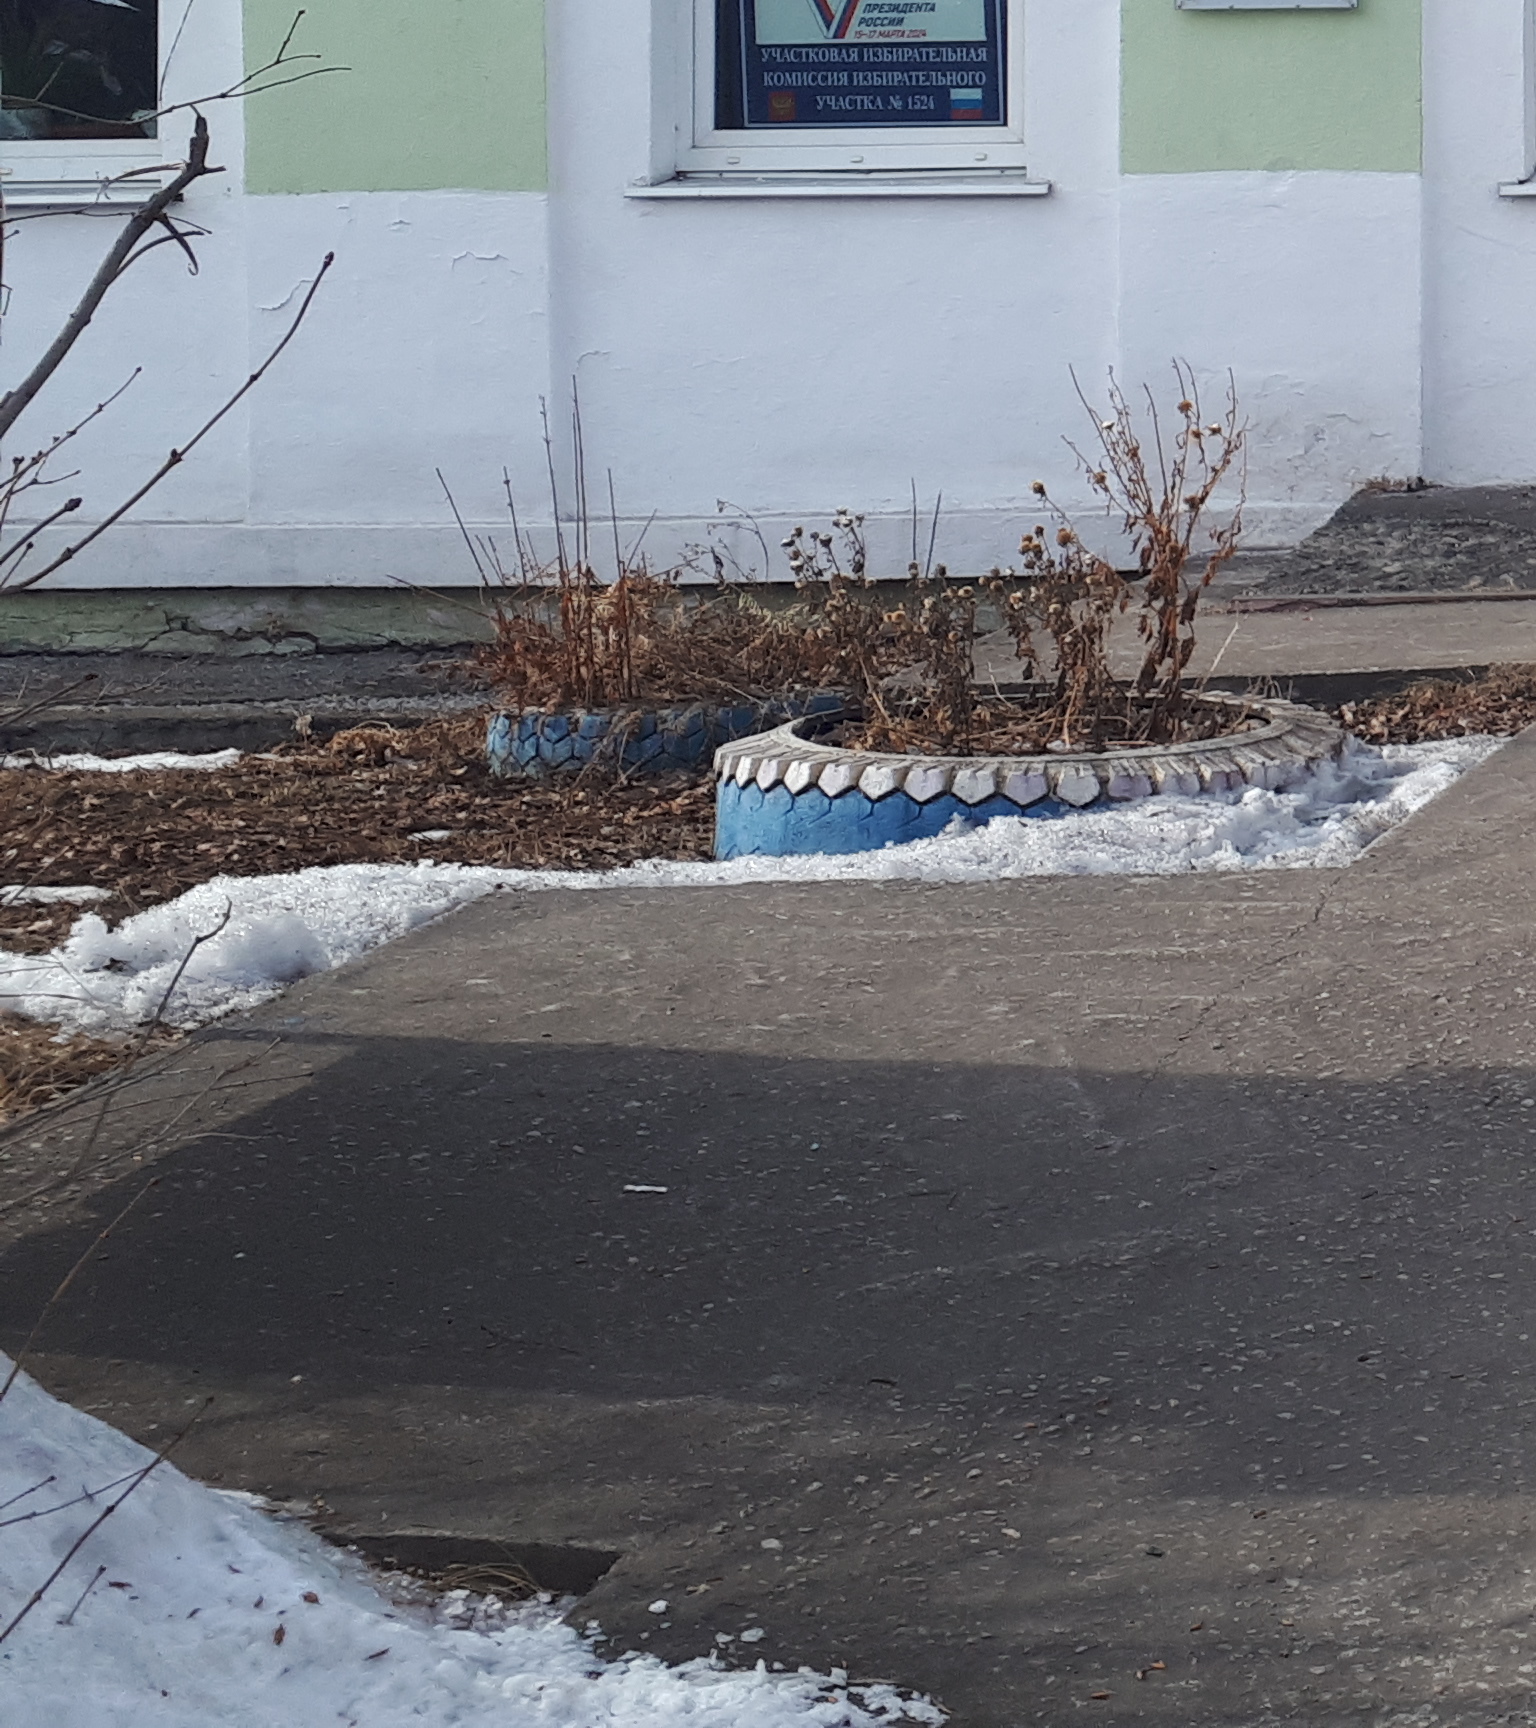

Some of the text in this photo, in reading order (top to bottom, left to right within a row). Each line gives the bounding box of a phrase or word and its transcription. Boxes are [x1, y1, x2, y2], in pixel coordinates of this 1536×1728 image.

[863, 2, 936, 14] ПРЕЗИДЕНТА
[857, 16, 905, 27] РОССИИ
[761, 47, 988, 63] УЧАСТКОВАЯ ИЗБИРАТЕЛЬНАЯ
[763, 71, 986, 87] КОМИССИЯ ИЗБИРАТЕЛЬНОГО
[815, 95, 884, 111] УЧАСТКА
[907, 95, 935, 110] 1524
